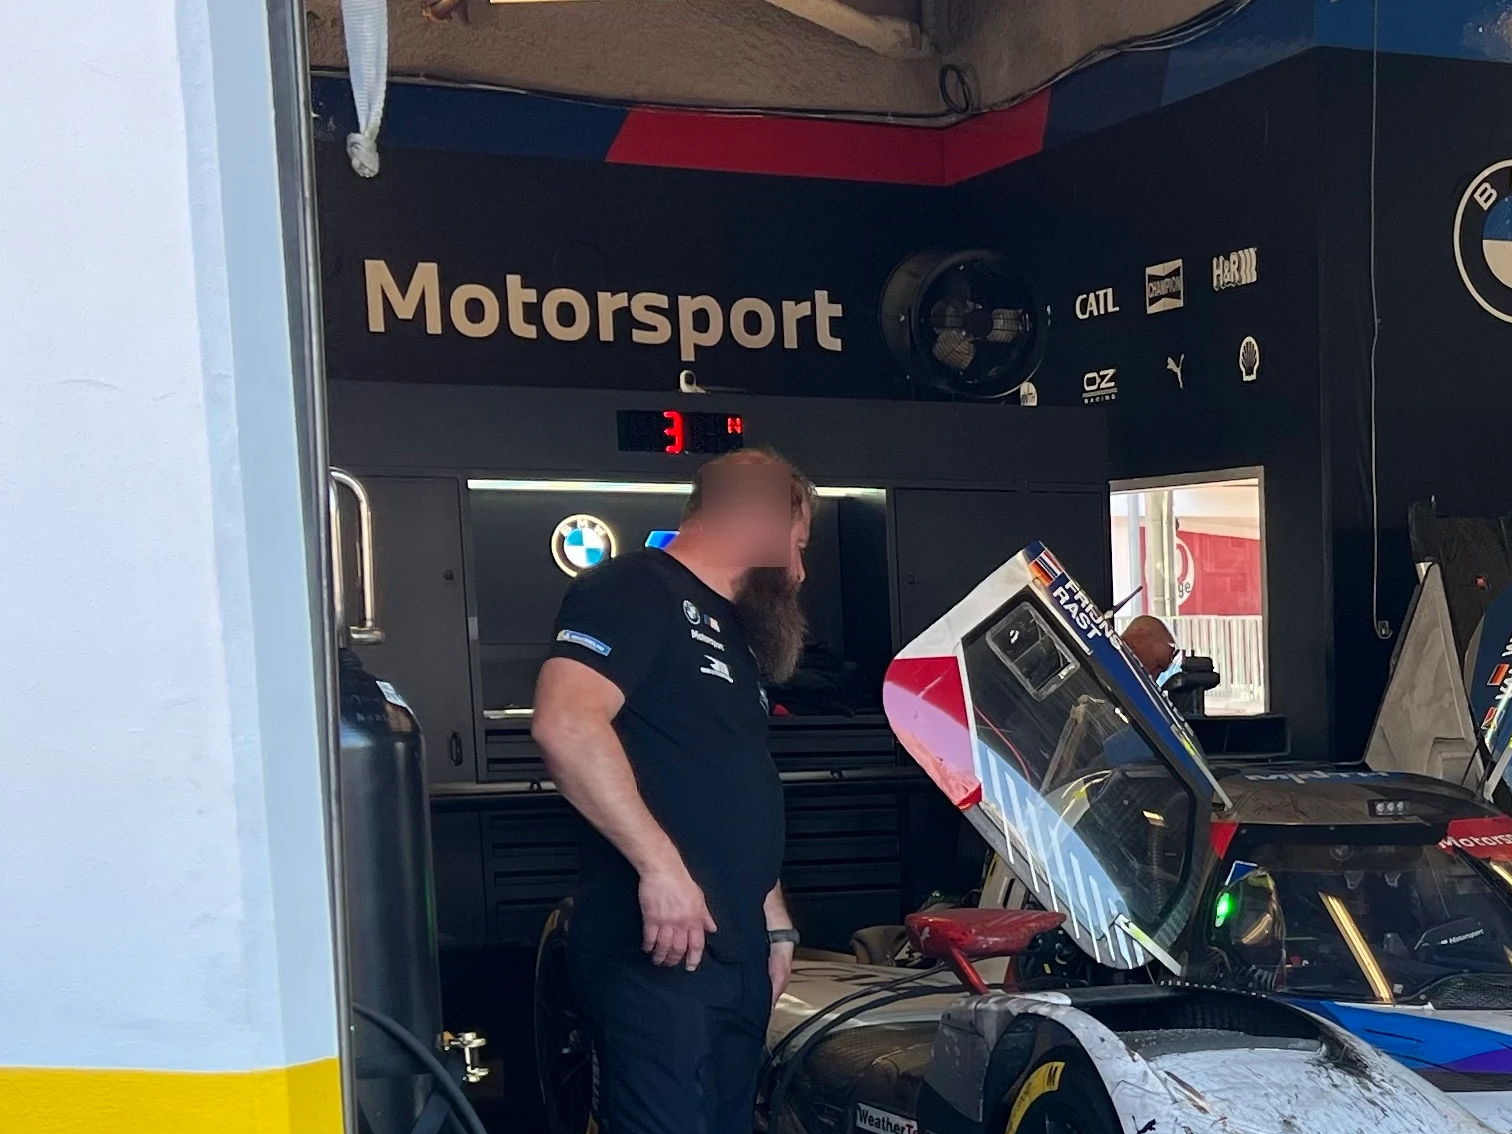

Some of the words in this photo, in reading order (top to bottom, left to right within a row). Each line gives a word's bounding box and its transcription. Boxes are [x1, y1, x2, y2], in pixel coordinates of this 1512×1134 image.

[363, 258, 844, 362] Motorsport
[1075, 287, 1120, 320] CATL
[1083, 368, 1116, 391] OZ
[662, 411, 683, 454] 3
[1052, 586, 1102, 639] RAST
